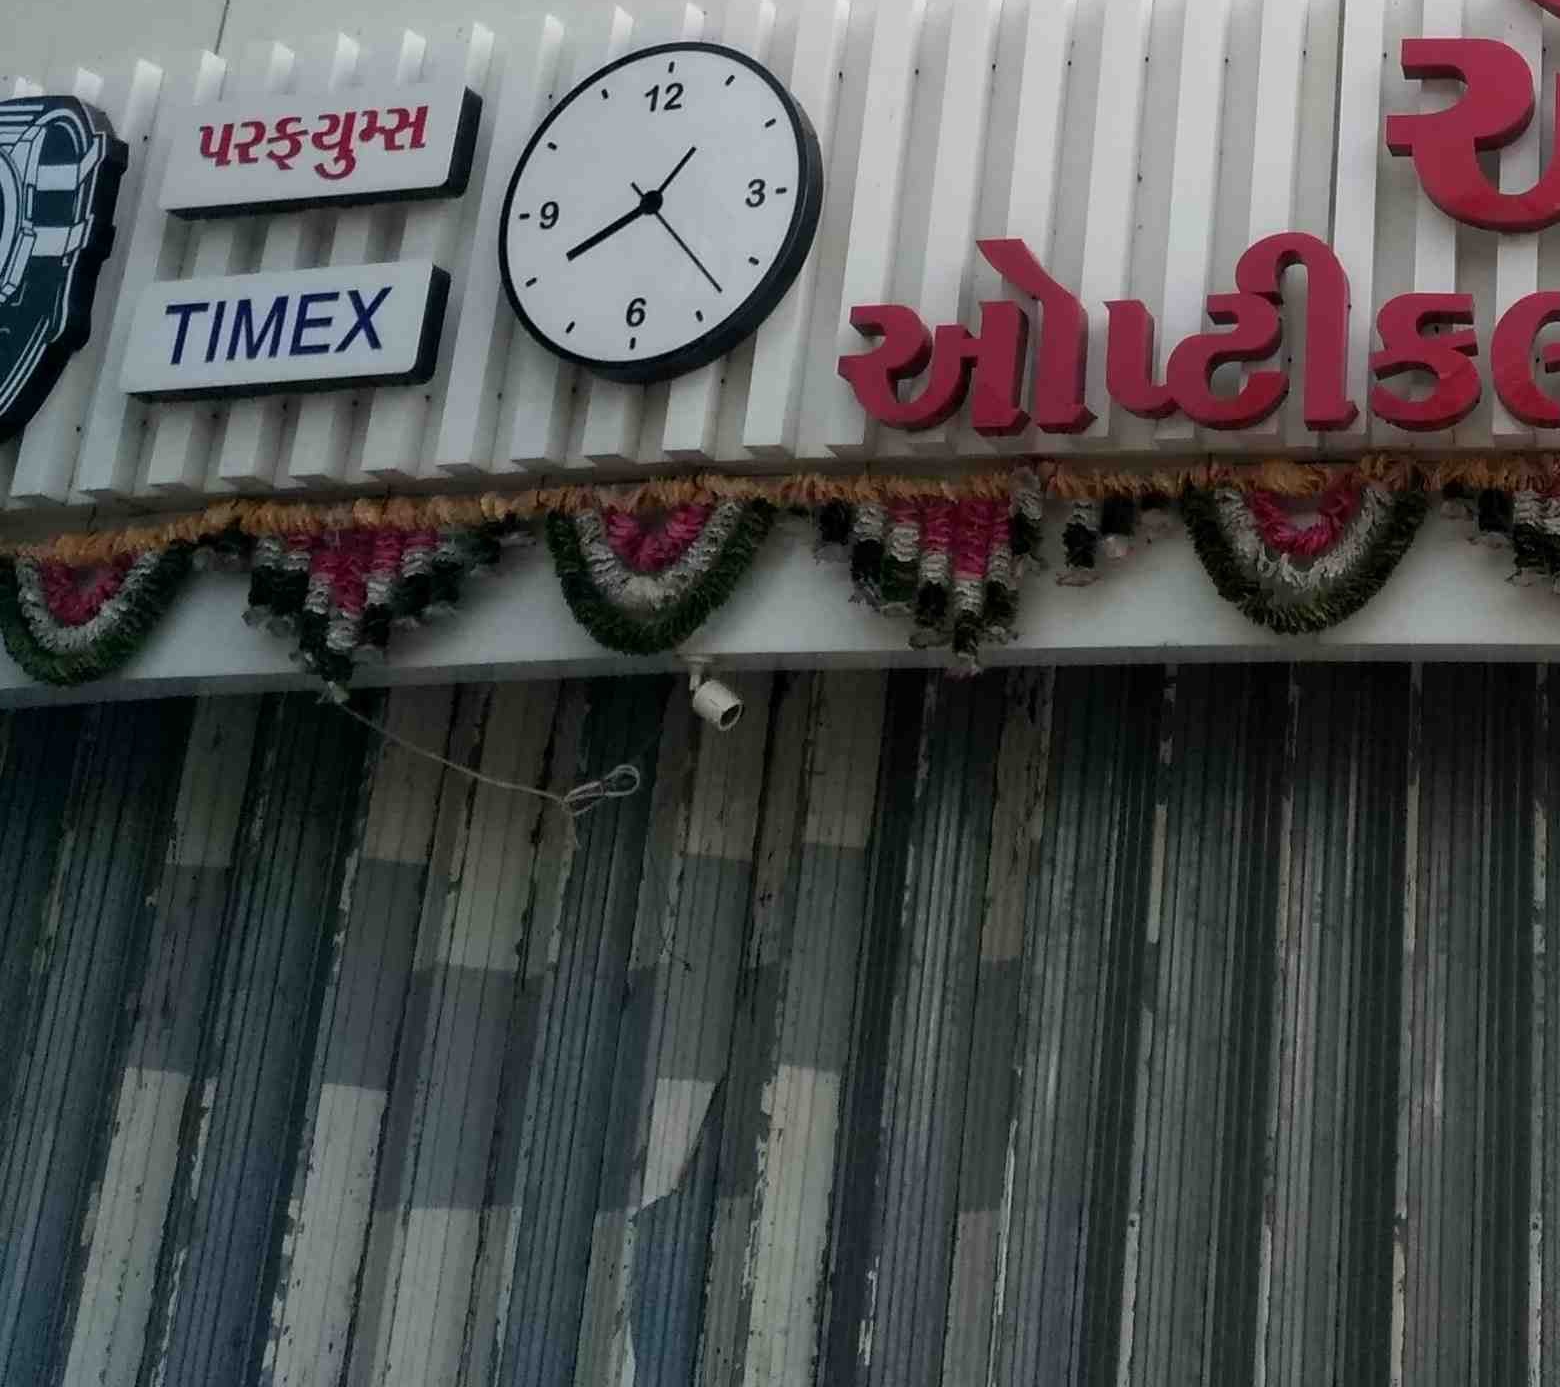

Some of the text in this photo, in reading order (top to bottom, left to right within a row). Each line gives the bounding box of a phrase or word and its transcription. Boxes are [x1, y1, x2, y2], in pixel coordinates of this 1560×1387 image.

[645, 82, 685, 113] 12
[539, 178, 767, 230] 9 3
[165, 286, 393, 366] TIMEX
[625, 297, 647, 327] 6
